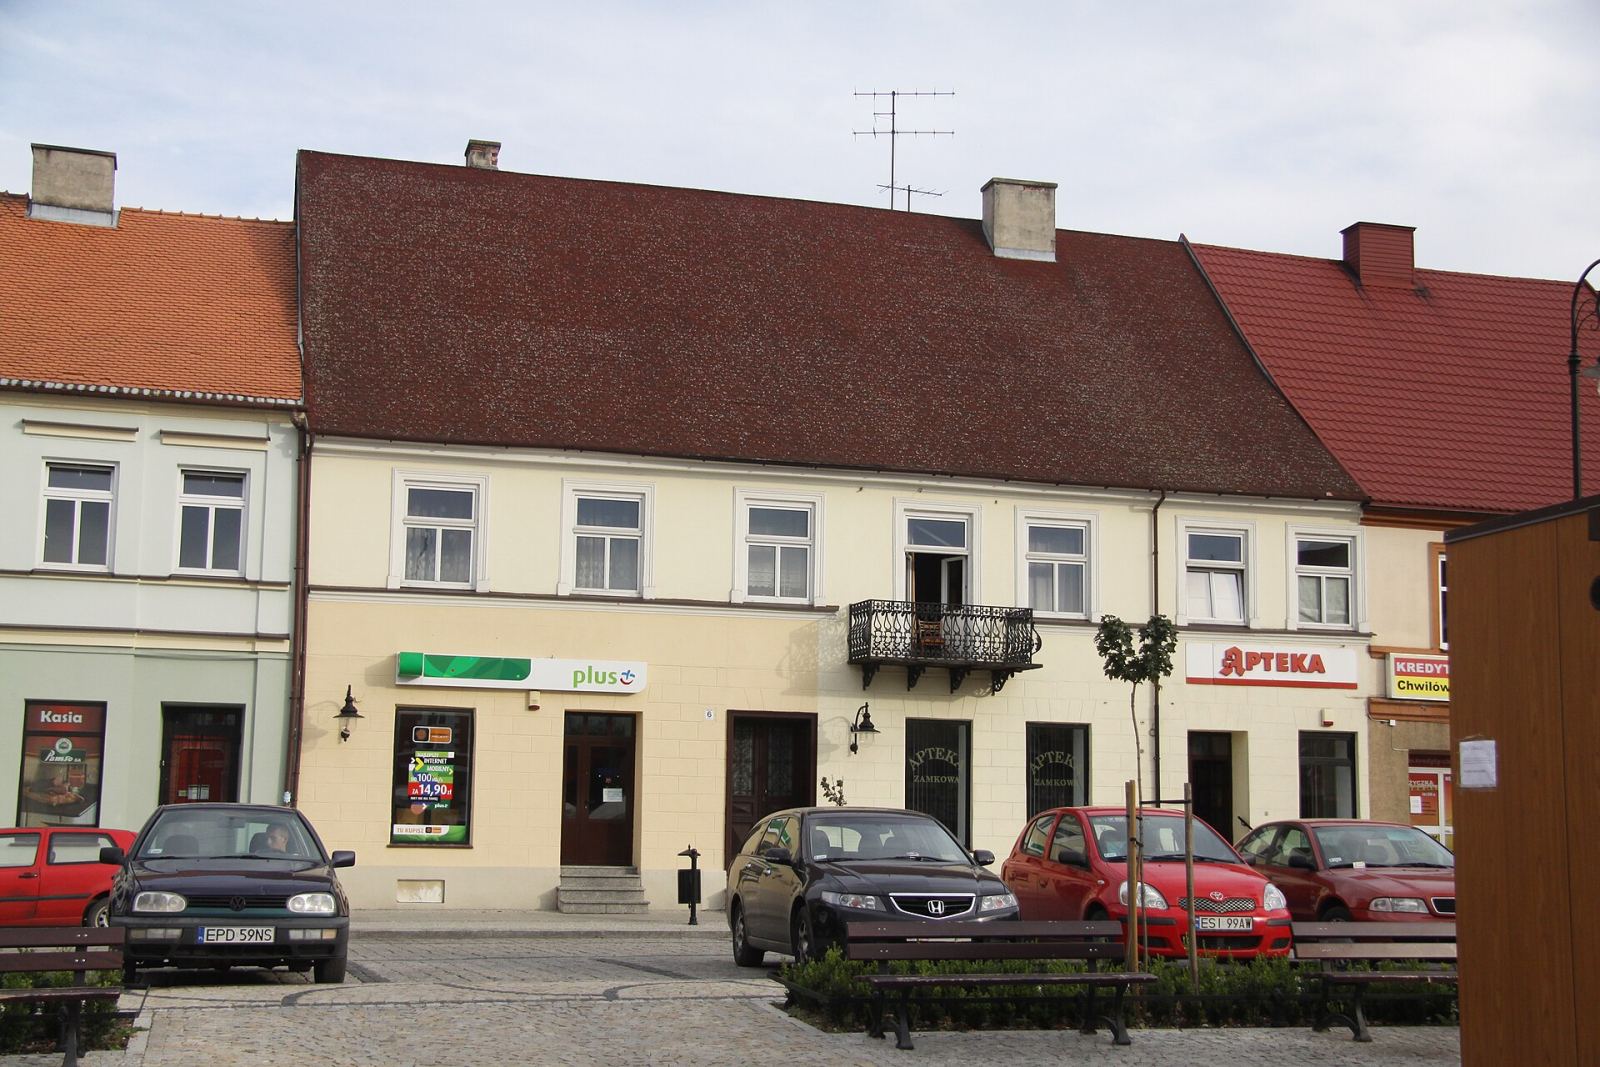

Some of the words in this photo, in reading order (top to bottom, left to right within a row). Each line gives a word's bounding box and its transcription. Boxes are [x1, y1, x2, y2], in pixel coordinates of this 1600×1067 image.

[1219, 646, 1326, 677] APTEKA
[573, 665, 618, 689] plus
[40, 710, 83, 723] Kasia
[706, 710, 713, 718] 6
[417, 773, 432, 782] 100
[1034, 779, 1078, 788] ZAMKOW
[419, 784, 447, 797] 14,90
[205, 929, 235, 942] EPD
[239, 929, 272, 942] 59NS
